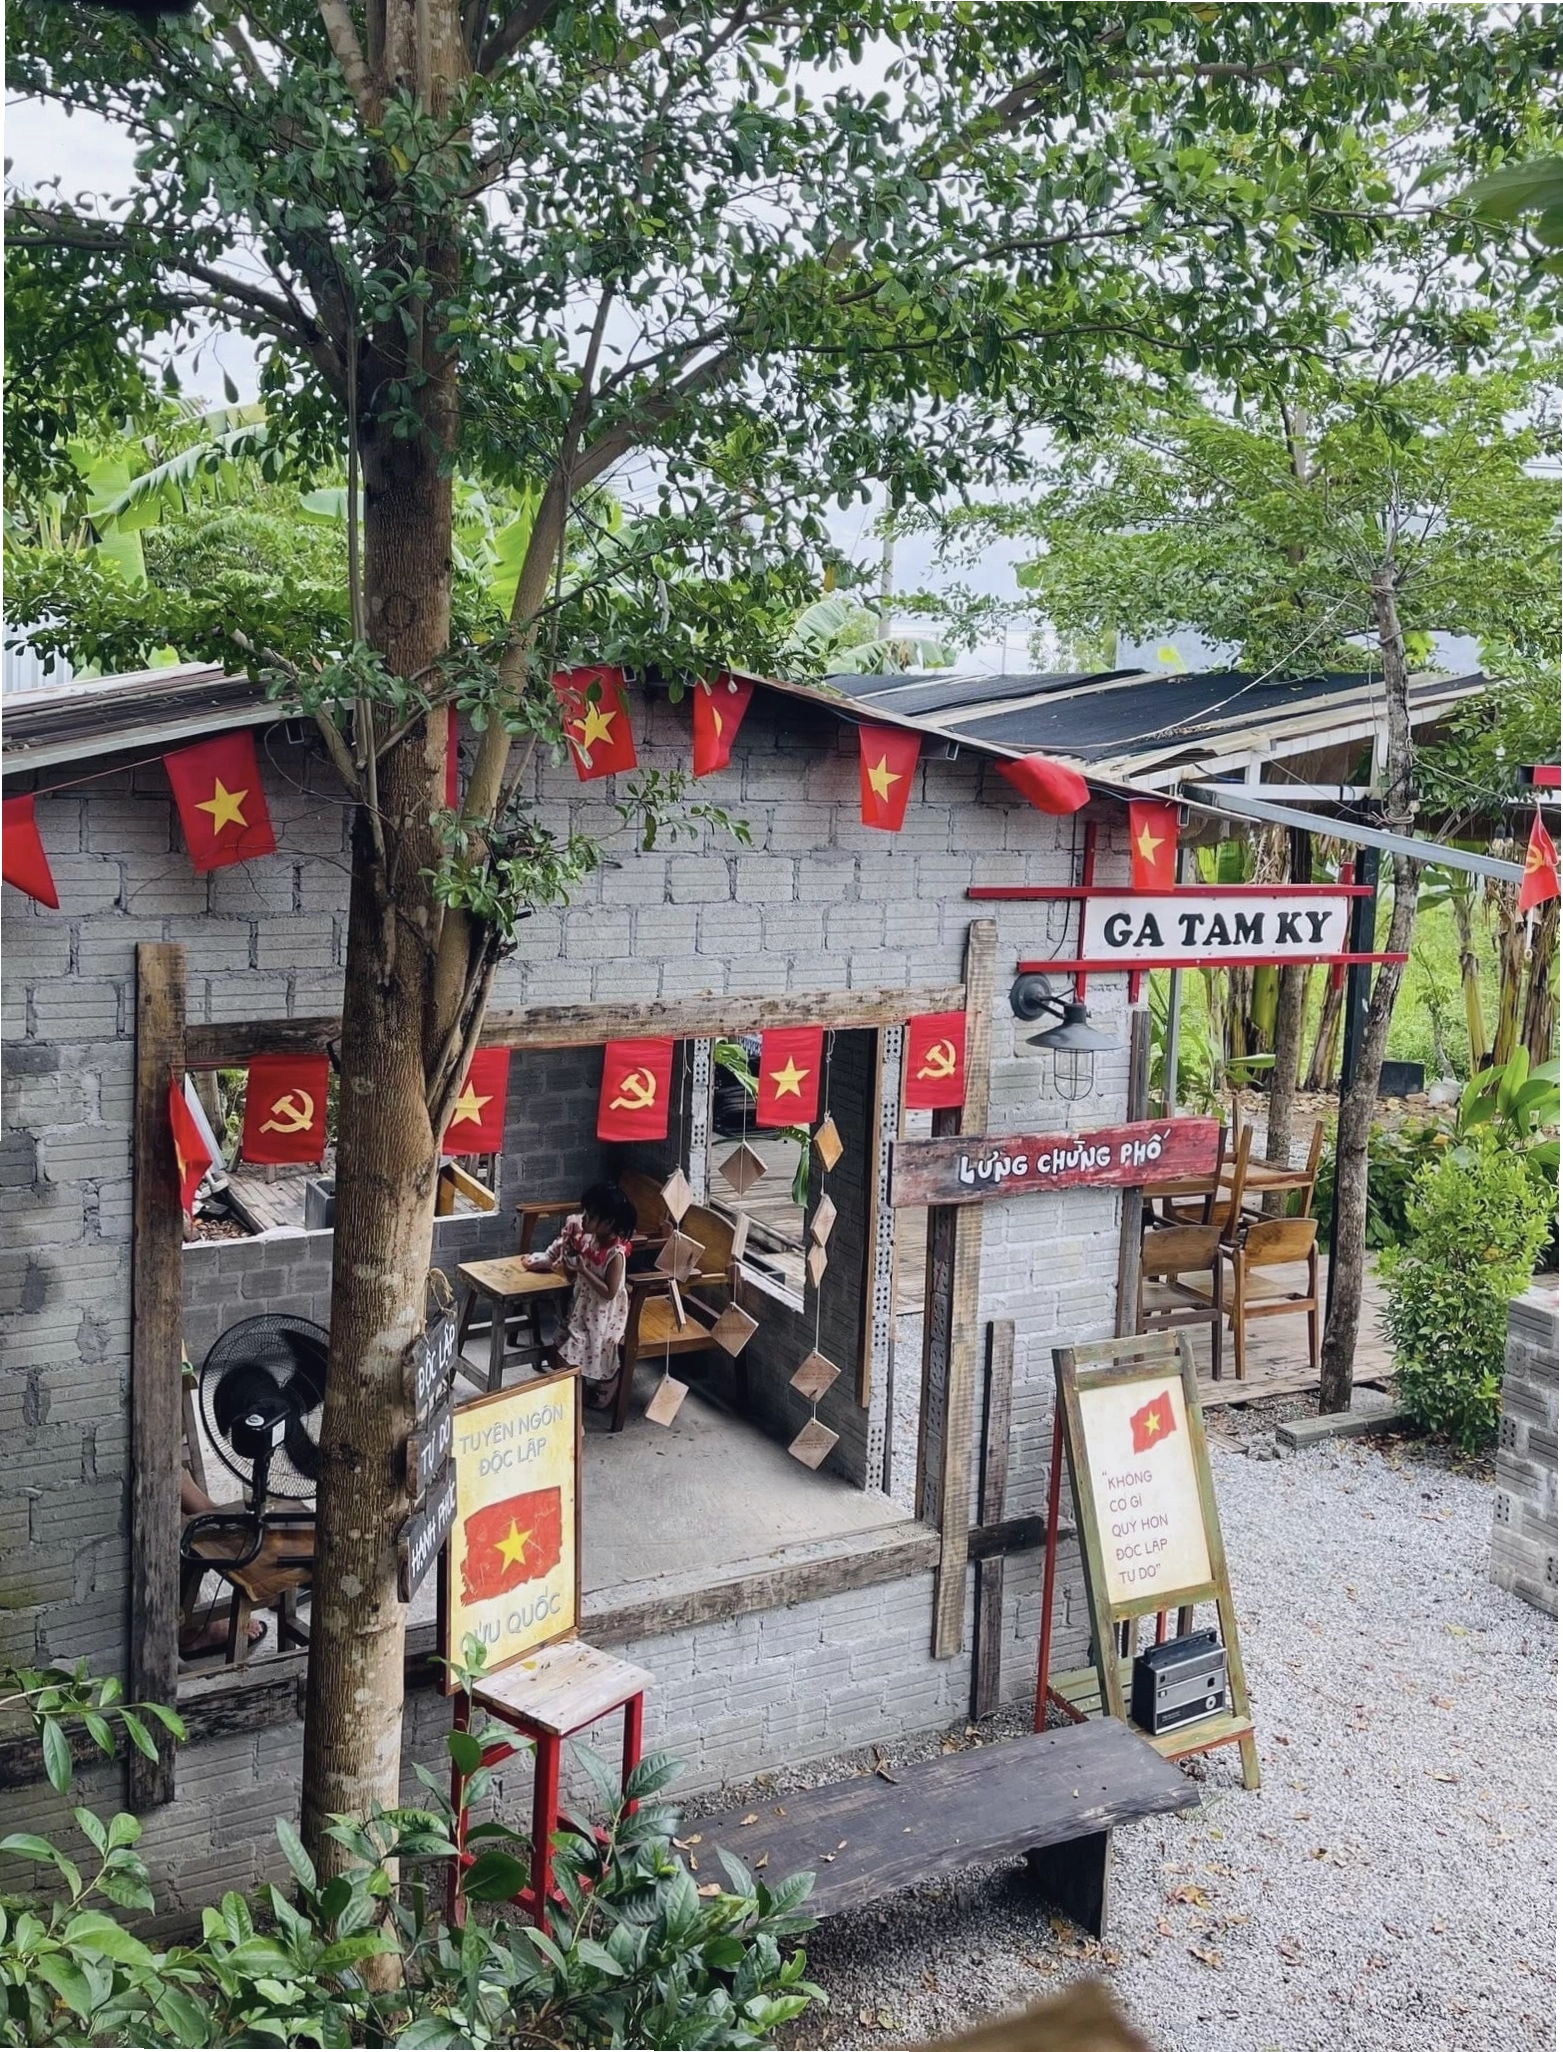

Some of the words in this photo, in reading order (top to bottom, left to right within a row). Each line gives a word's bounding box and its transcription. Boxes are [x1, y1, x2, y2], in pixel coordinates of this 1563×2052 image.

[1103, 912, 1164, 948] GA
[1178, 911, 1266, 946] TAM
[1275, 910, 1333, 944] KY
[960, 1150, 1028, 1184] LƯNG
[1120, 1128, 1171, 1167] PHỐ
[418, 1348, 437, 1399] ĐỘC
[438, 1322, 456, 1370] LẬP
[439, 1414, 451, 1453] DO
[459, 1420, 514, 1455] TUYÊN
[518, 1403, 564, 1435] NGÔN
[479, 1449, 513, 1477] ĐỘC
[517, 1436, 547, 1463] LẬP
[411, 1515, 436, 1578] HẠNH
[507, 1585, 561, 1634] QUỐC
